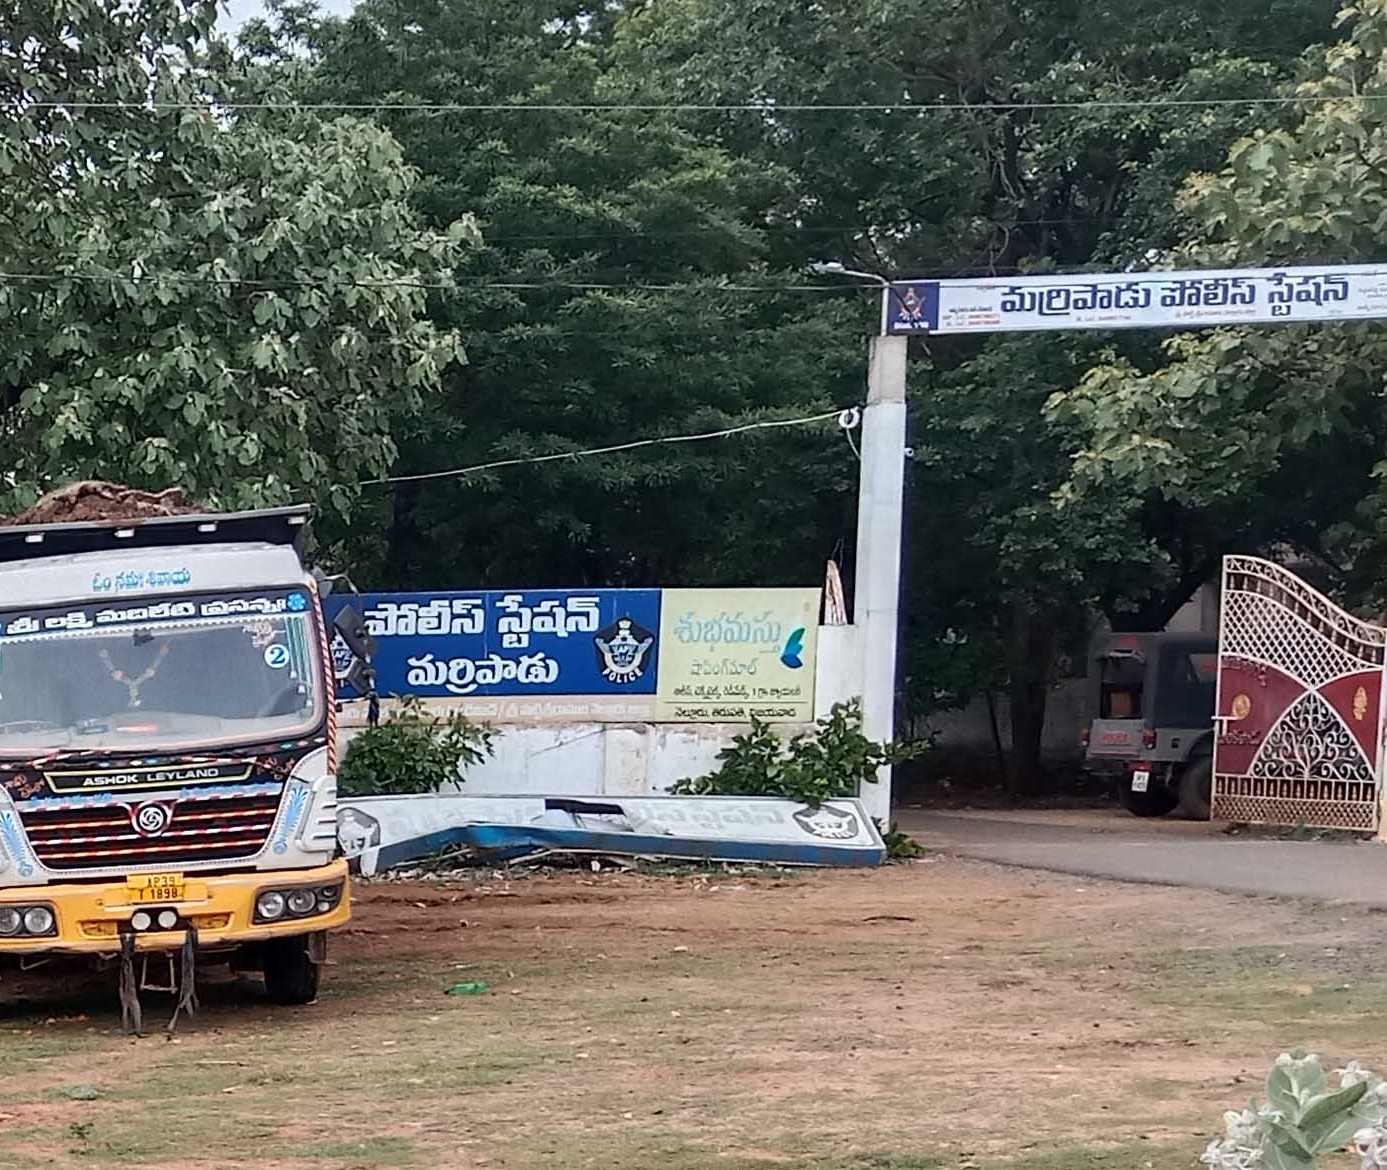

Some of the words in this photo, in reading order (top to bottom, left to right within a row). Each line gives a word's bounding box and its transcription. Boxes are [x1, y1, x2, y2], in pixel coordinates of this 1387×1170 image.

[1001, 282, 1151, 315] మర్రిపాడు
[1160, 277, 1256, 307] పోలీస్
[1268, 272, 1349, 316] స్టేషన్
[364, 598, 485, 636] పోలీస్
[495, 593, 600, 649] స్టేషన్
[269, 646, 286, 665] 2
[406, 652, 560, 693] మర్రిపాడు
[602, 667, 644, 683] POLICE
[82, 773, 138, 786] ASHOK
[147, 768, 220, 783] LEYLAND
